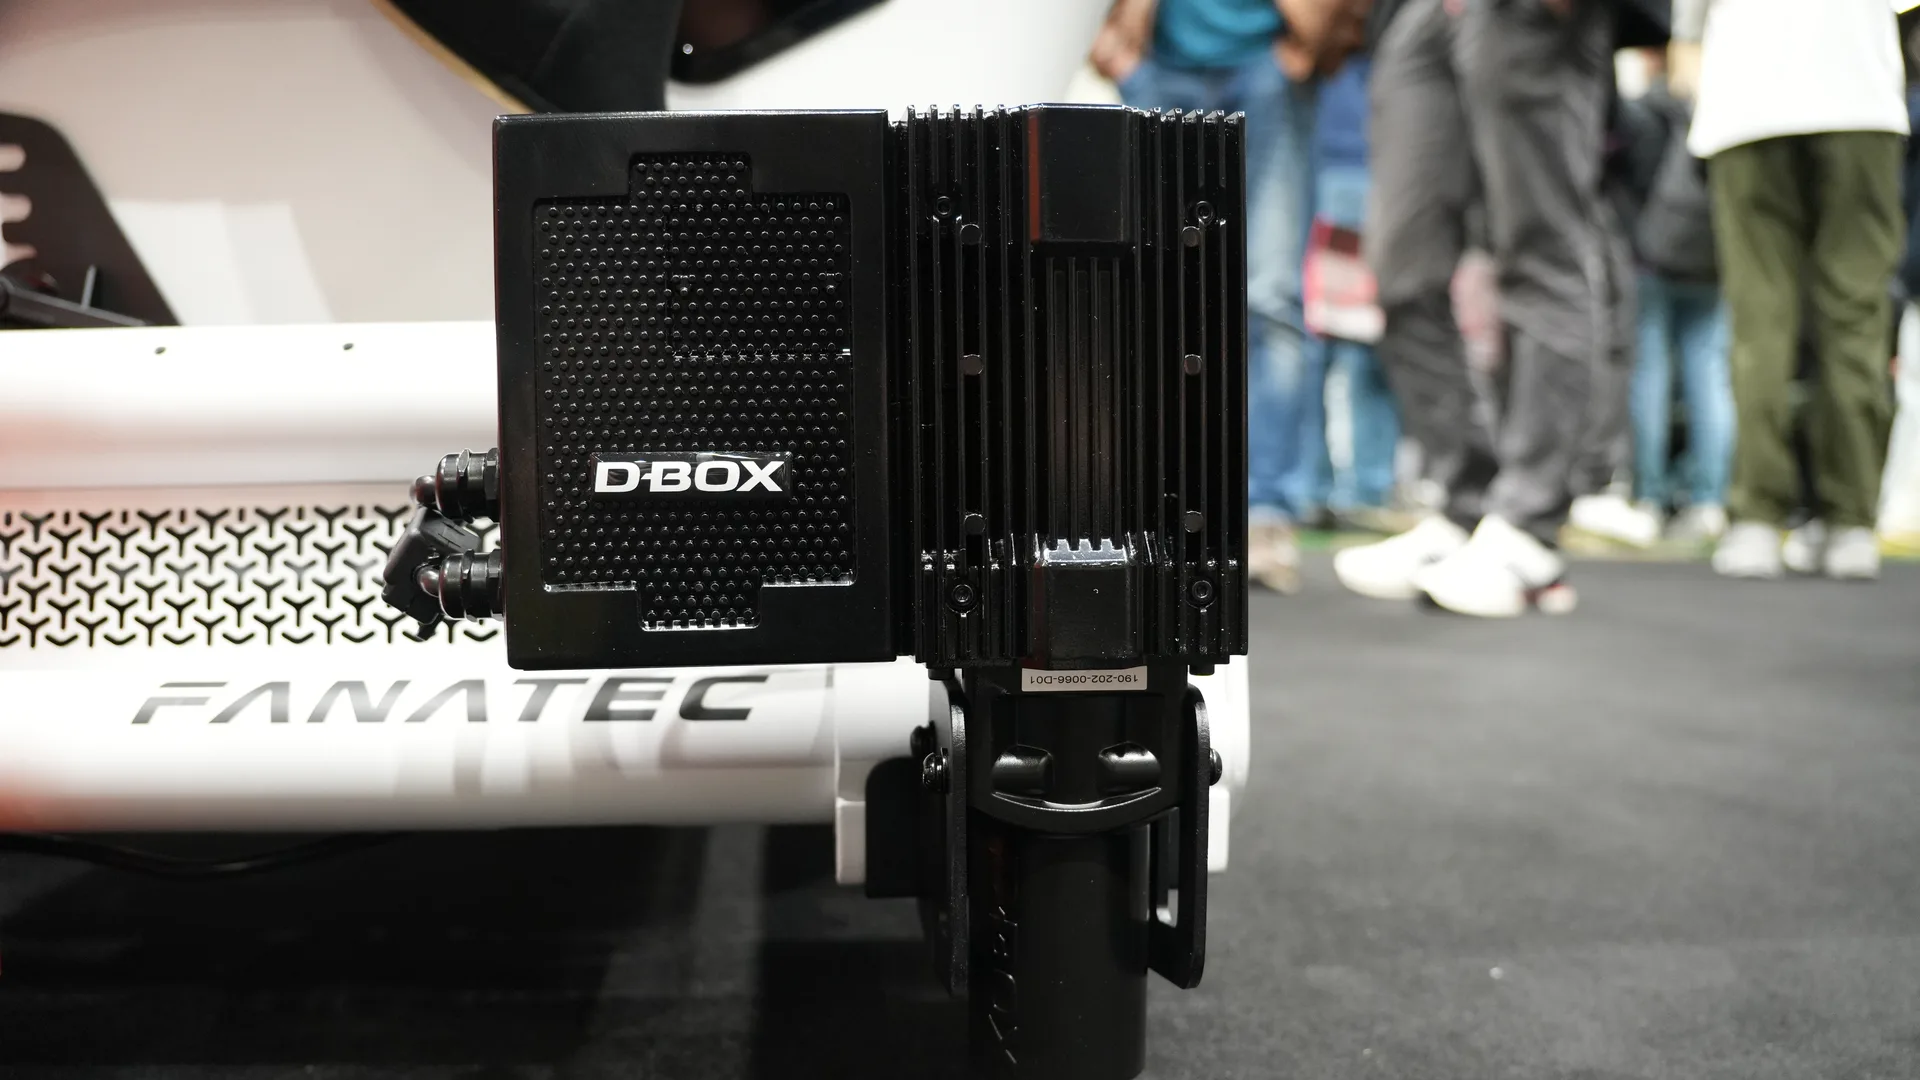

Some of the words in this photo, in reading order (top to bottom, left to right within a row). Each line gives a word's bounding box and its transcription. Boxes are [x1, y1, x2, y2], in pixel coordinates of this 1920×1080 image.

[594, 460, 785, 493] D-BOX
[1029, 674, 1139, 686] 190-202-0066-D01
[131, 674, 770, 724] FANATEC
